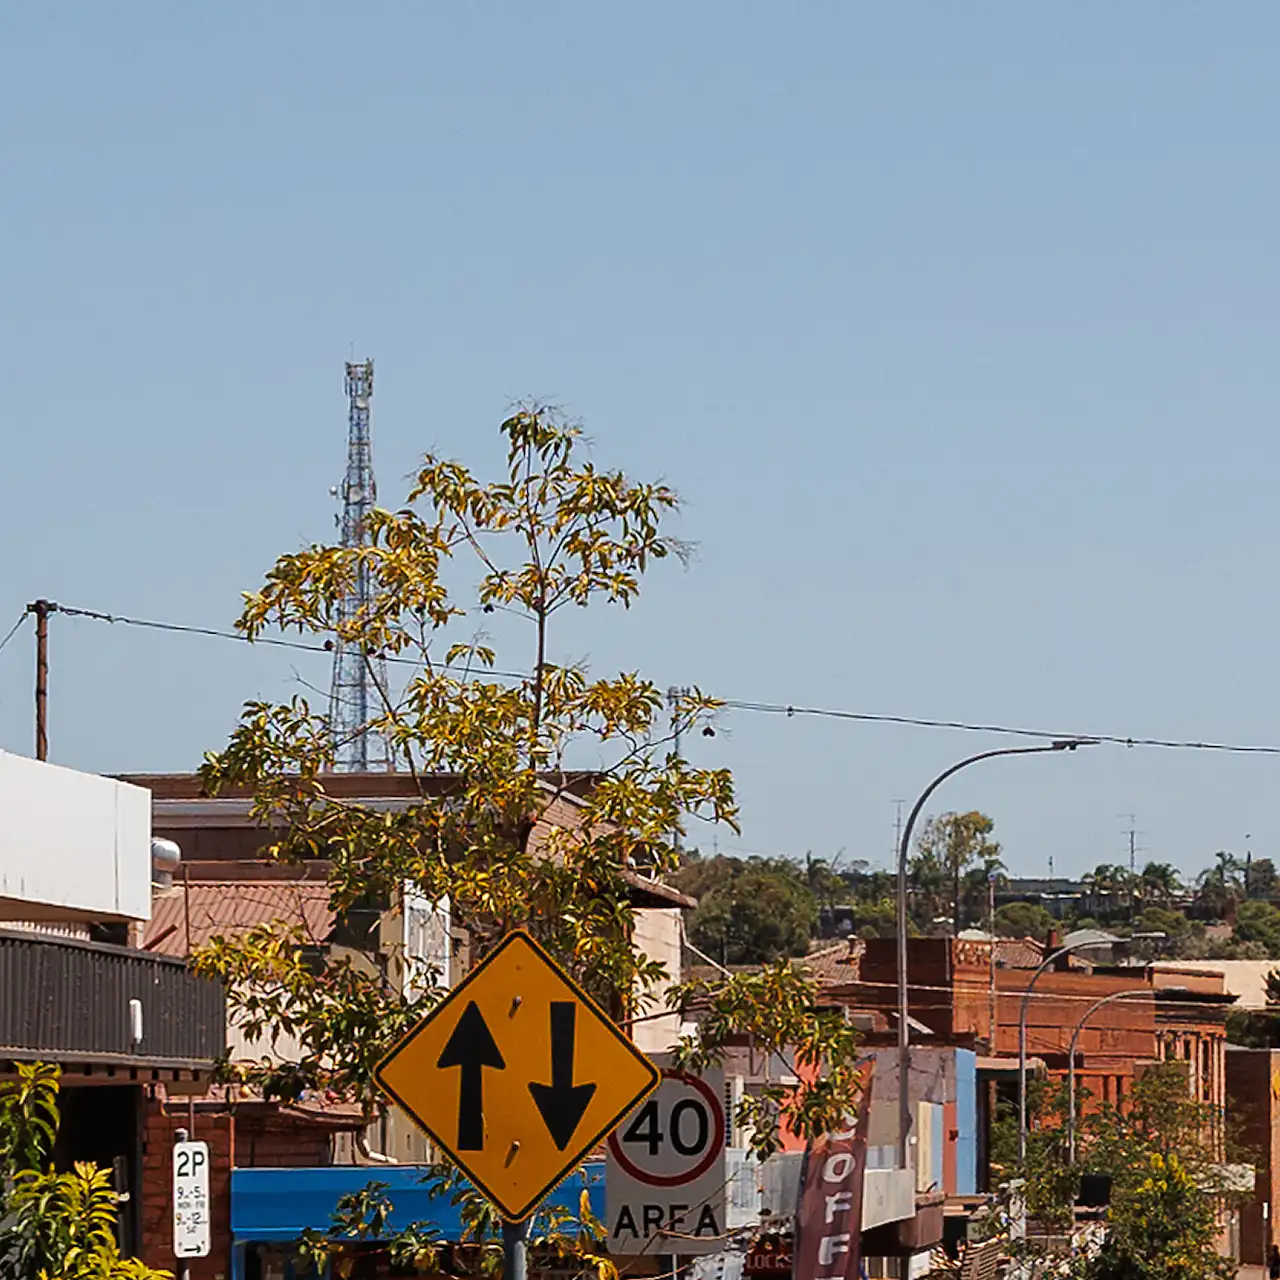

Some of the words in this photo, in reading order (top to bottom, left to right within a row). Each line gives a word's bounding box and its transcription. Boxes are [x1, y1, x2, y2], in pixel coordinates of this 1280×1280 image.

[623, 1099, 708, 1156] 40
[177, 1151, 205, 1177] 2P
[613, 1205, 720, 1238] AREA
